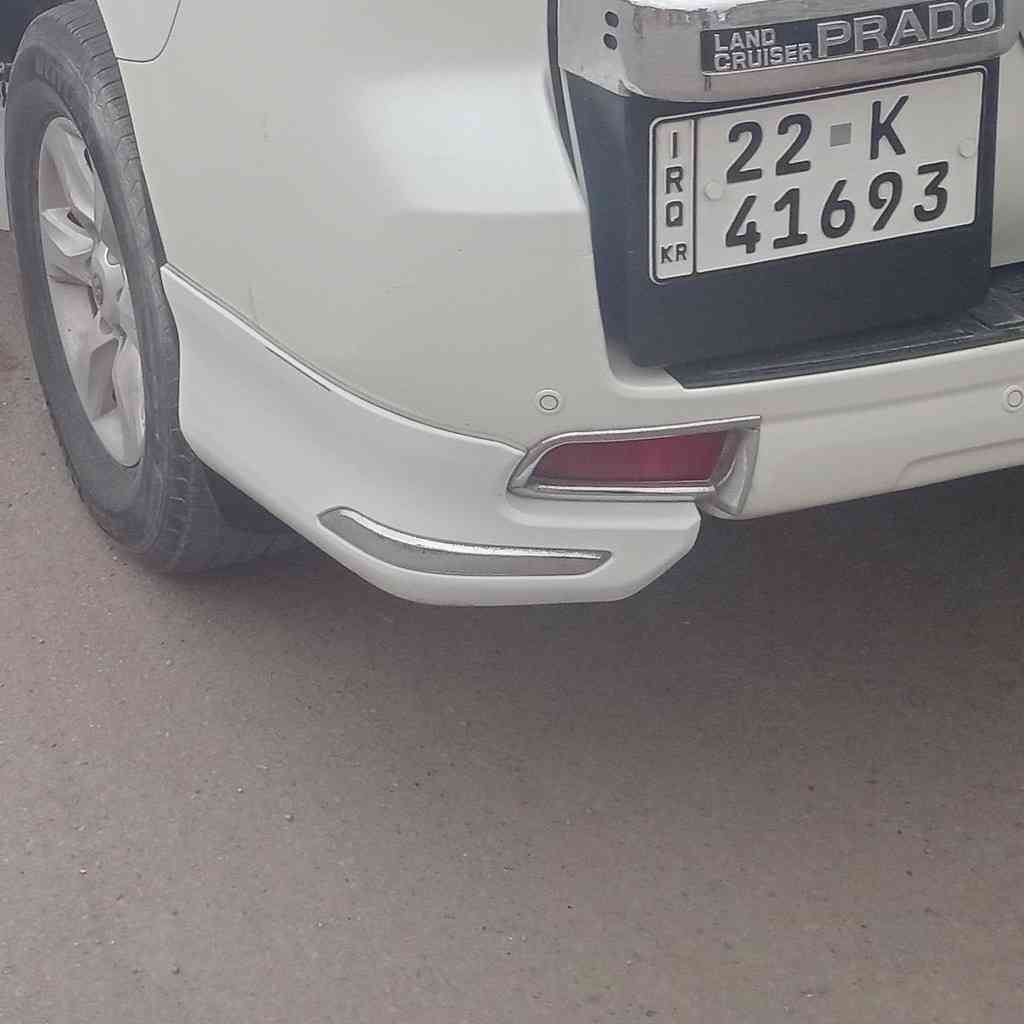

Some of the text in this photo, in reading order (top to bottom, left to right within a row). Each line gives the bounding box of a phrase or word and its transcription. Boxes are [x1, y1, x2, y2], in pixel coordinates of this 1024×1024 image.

[713, 28, 776, 54] LAND
[713, 42, 813, 72] CRUISER
[727, 95, 910, 184] 22 K
[725, 161, 950, 255] 41693
[660, 242, 688, 265] KR
